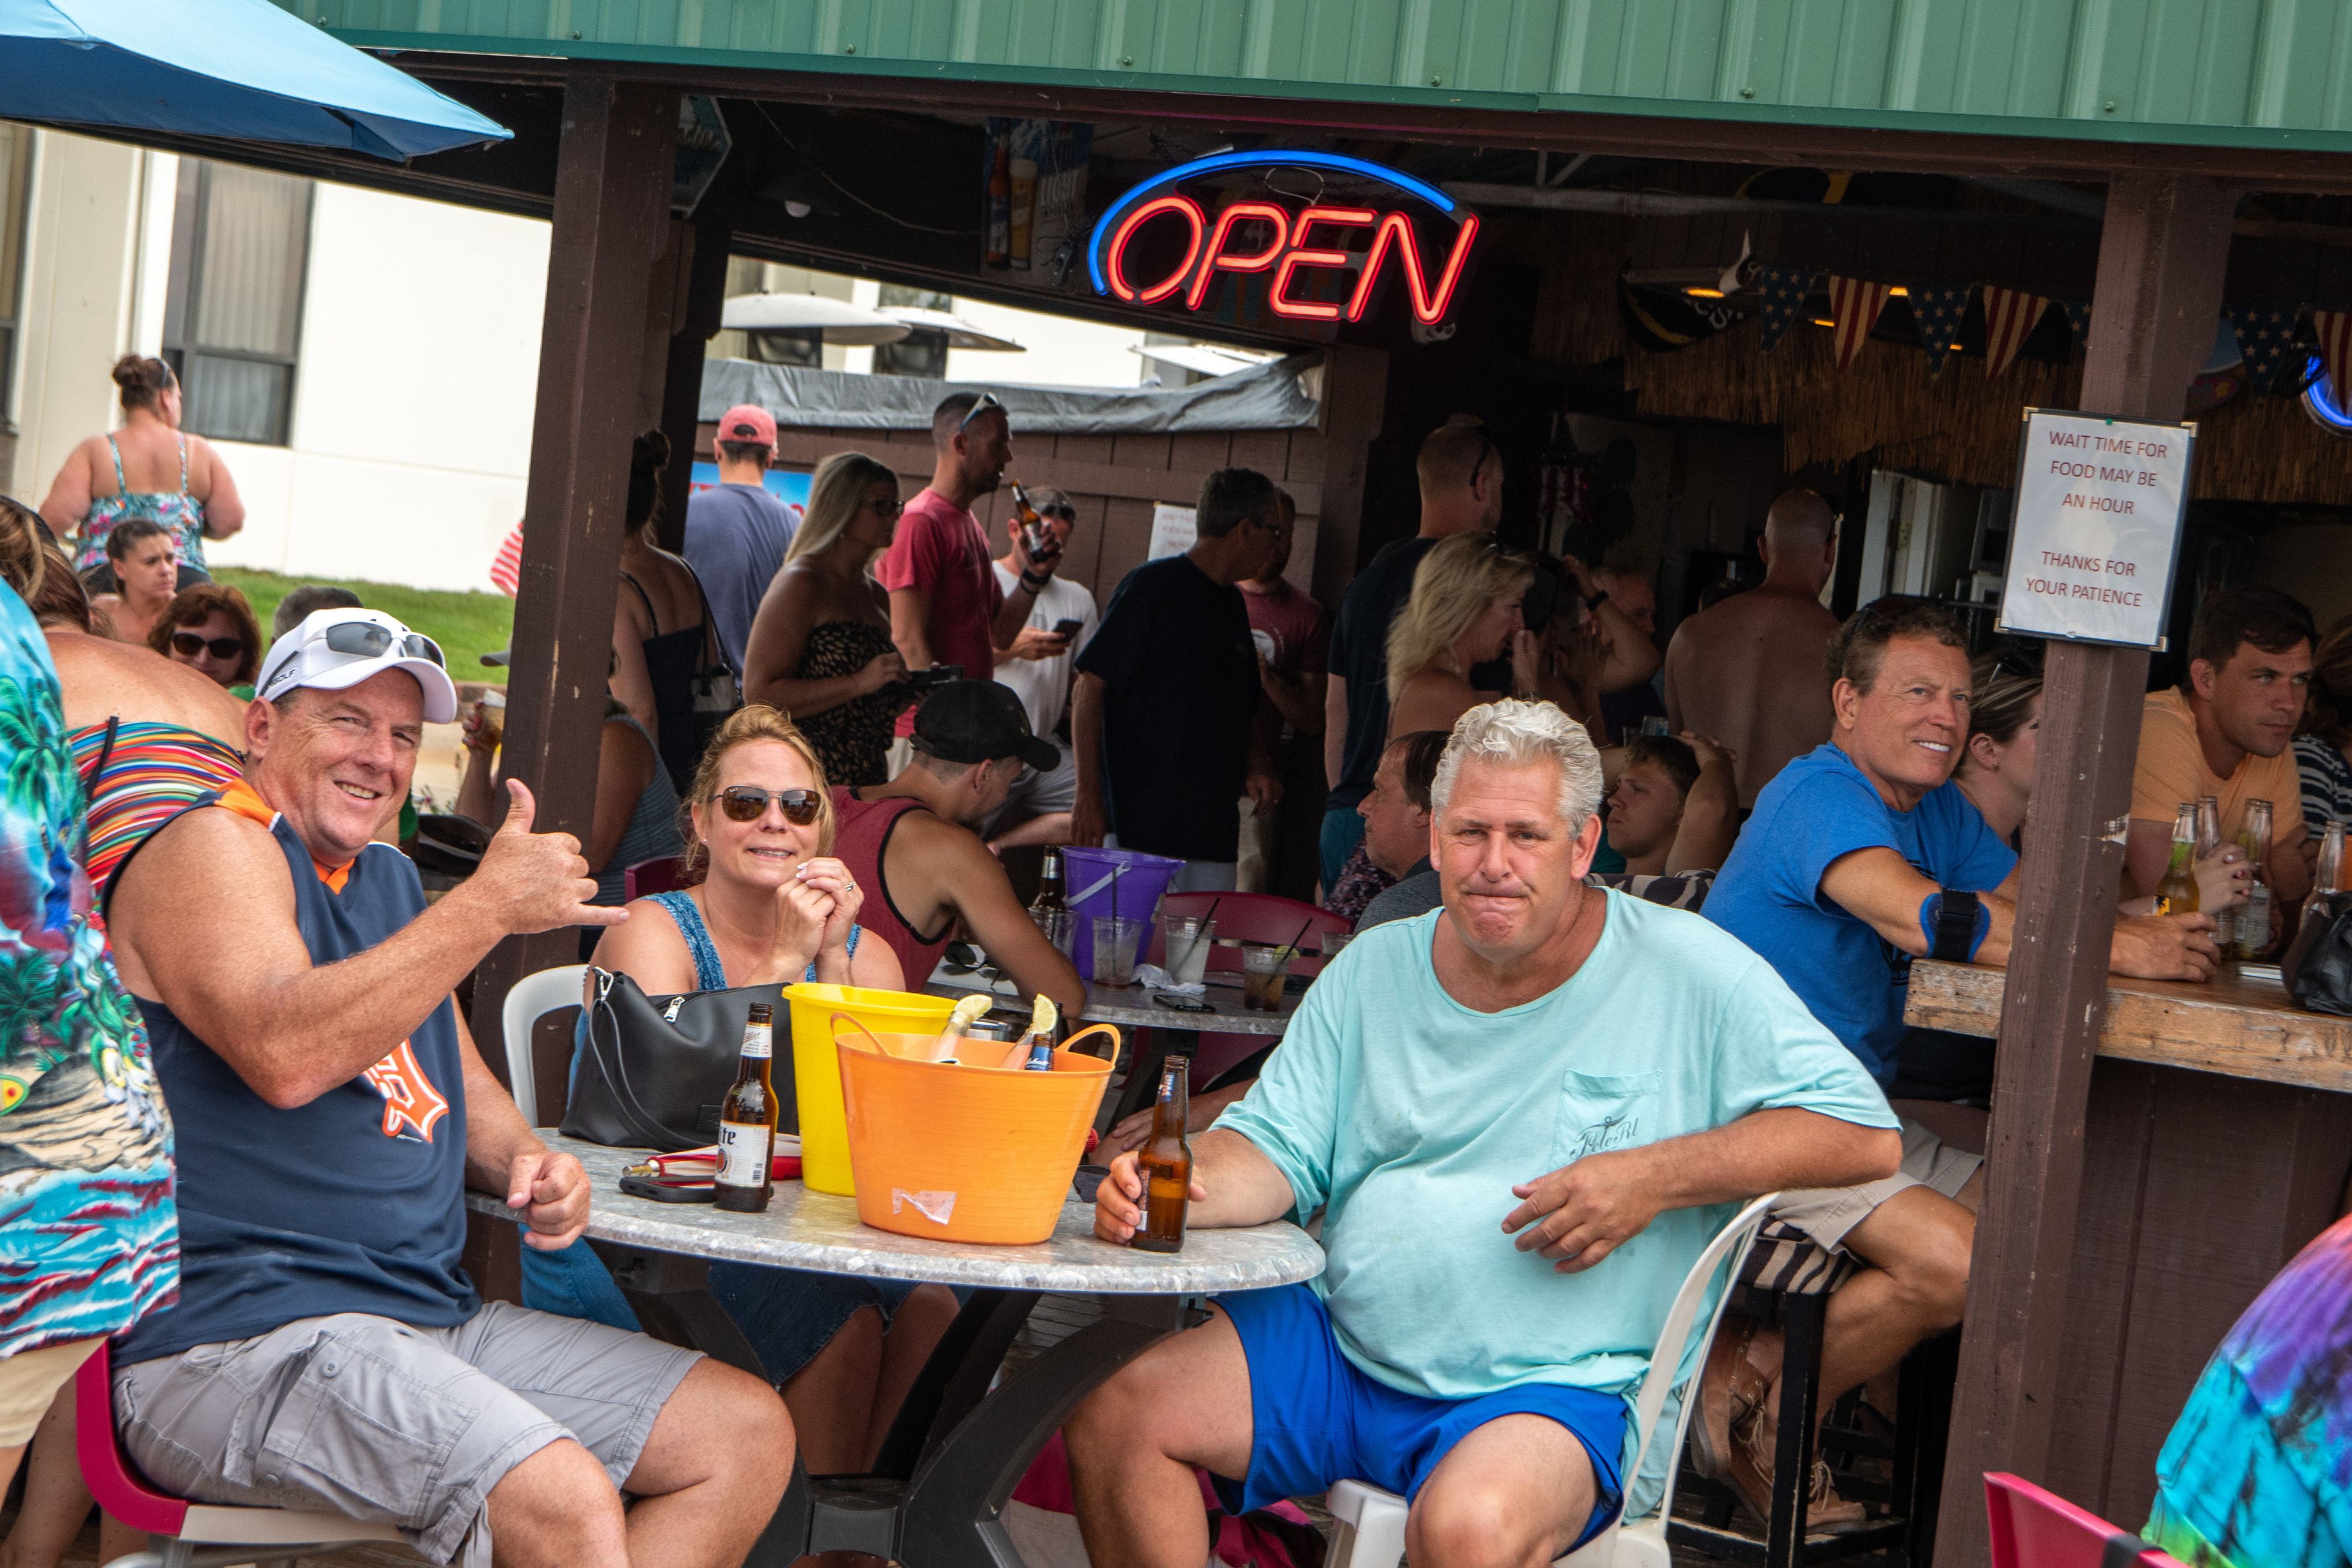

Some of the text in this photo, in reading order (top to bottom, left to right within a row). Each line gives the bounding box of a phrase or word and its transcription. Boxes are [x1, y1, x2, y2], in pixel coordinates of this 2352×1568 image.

[1107, 195, 1479, 325] OPEN
[2049, 431, 2168, 459] WAIT TIME FOR
[2050, 461, 2157, 486] FOOD MAY BE
[2062, 493, 2135, 514] AN HOUR
[2041, 551, 2136, 577] THANKS FOR
[2026, 578, 2143, 607] YOUR PATIENCE
